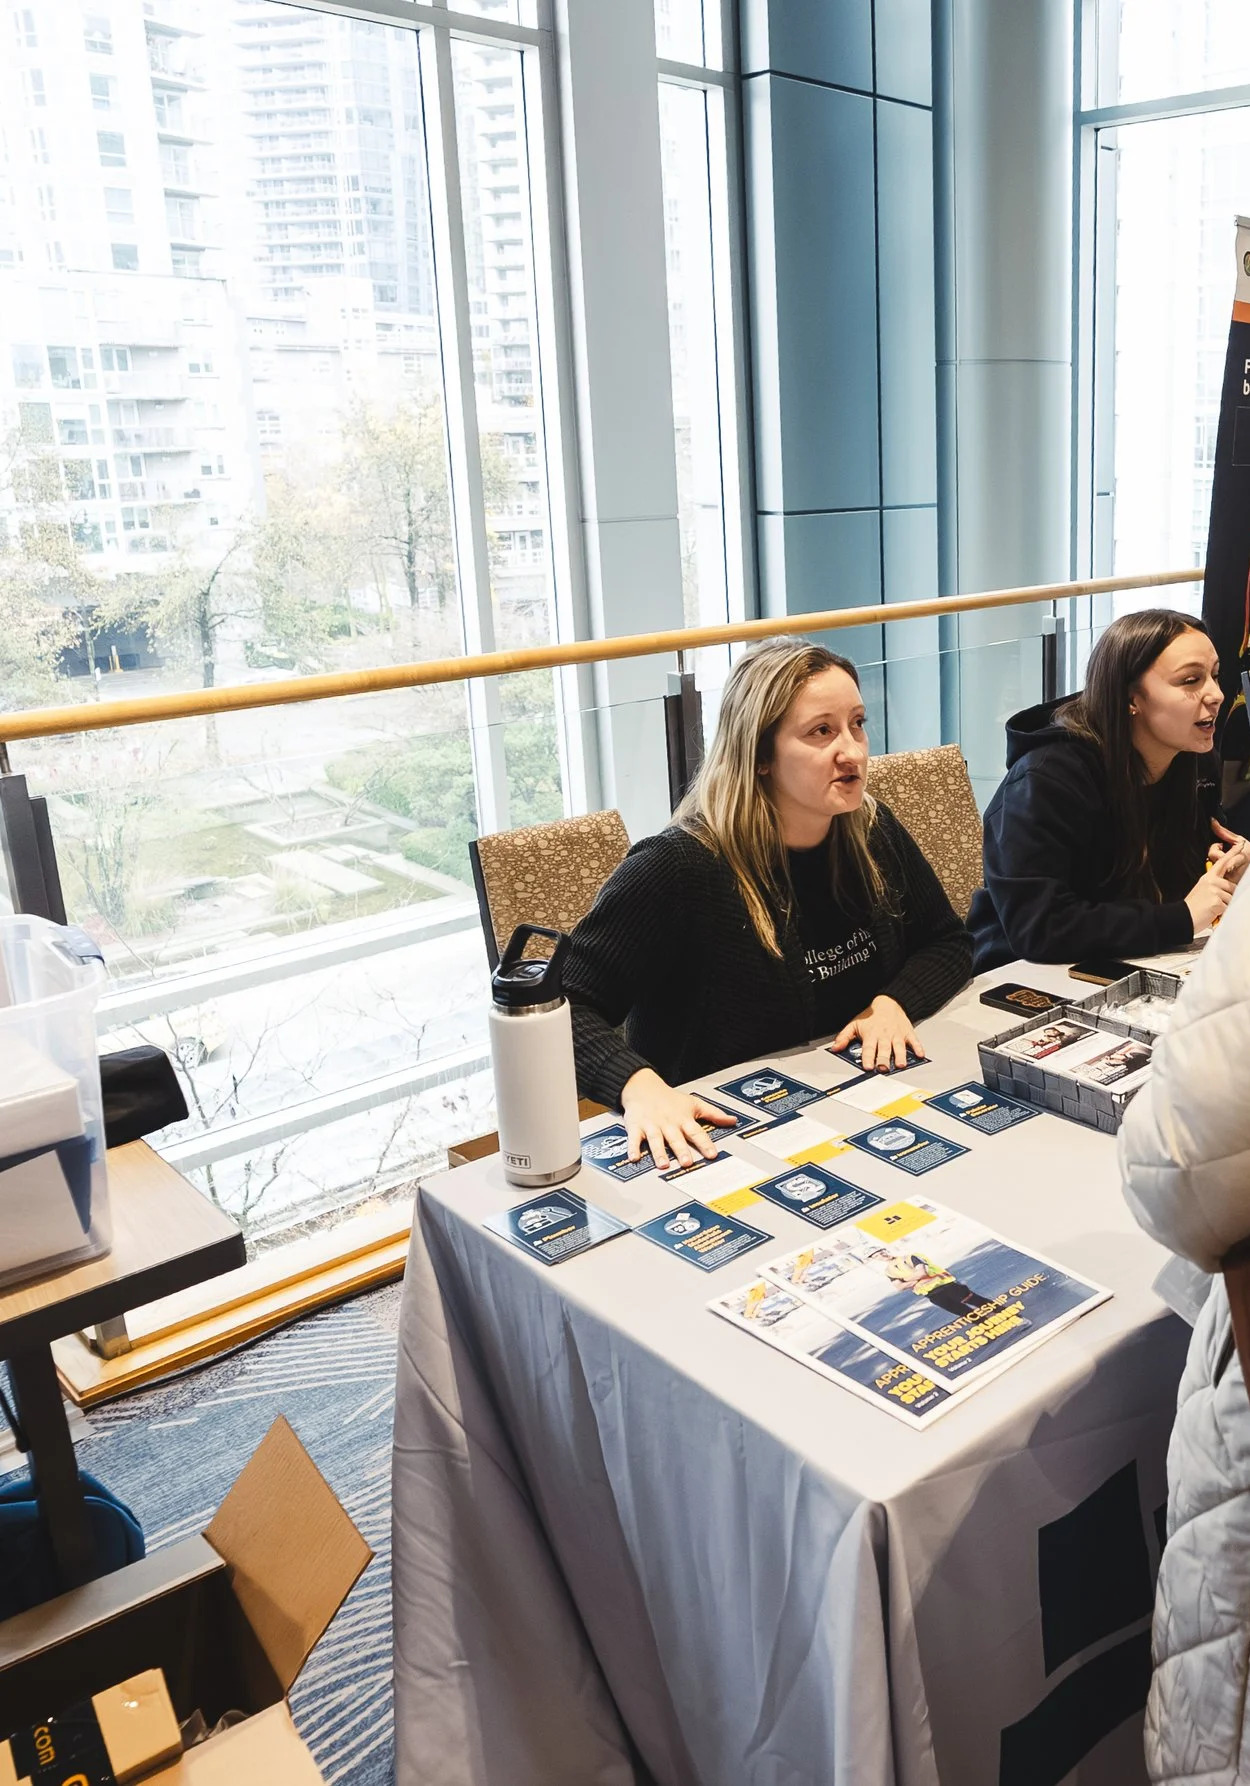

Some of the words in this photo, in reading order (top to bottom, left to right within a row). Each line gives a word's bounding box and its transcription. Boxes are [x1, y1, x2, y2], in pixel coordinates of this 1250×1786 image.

[804, 944, 844, 965] llege
[846, 932, 858, 950] of
[858, 928, 871, 942] th
[817, 948, 870, 980] Building
[911, 1294, 1009, 1353] APPRENTICESHIP
[923, 1335, 967, 1360] YOUR
[965, 1301, 1025, 1342] JOURNEY
[934, 1334, 988, 1368] STARTS
[988, 1315, 1024, 1340] HERE
[888, 1374, 923, 1396] YOU
[34, 1726, 56, 1766] com
